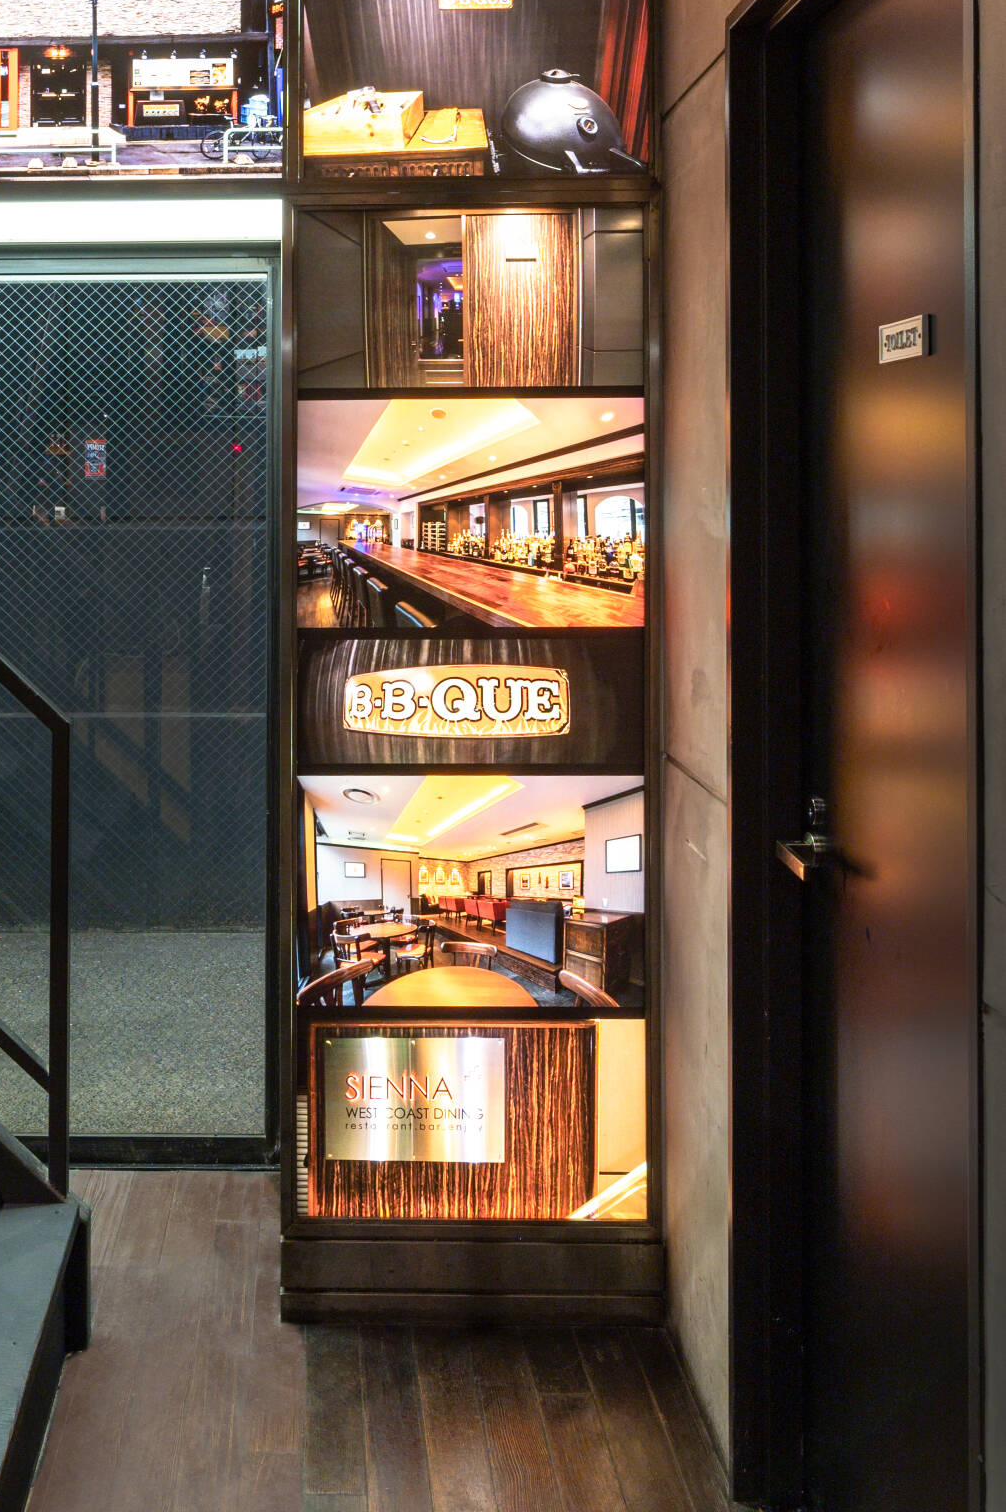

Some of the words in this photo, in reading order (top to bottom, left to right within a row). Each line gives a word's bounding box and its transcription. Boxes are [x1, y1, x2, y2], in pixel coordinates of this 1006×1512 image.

[886, 326, 919, 353] TOILET
[345, 1072, 453, 1102] SIENNA
[345, 1107, 377, 1119] WEST
[385, 1107, 430, 1120] COAST
